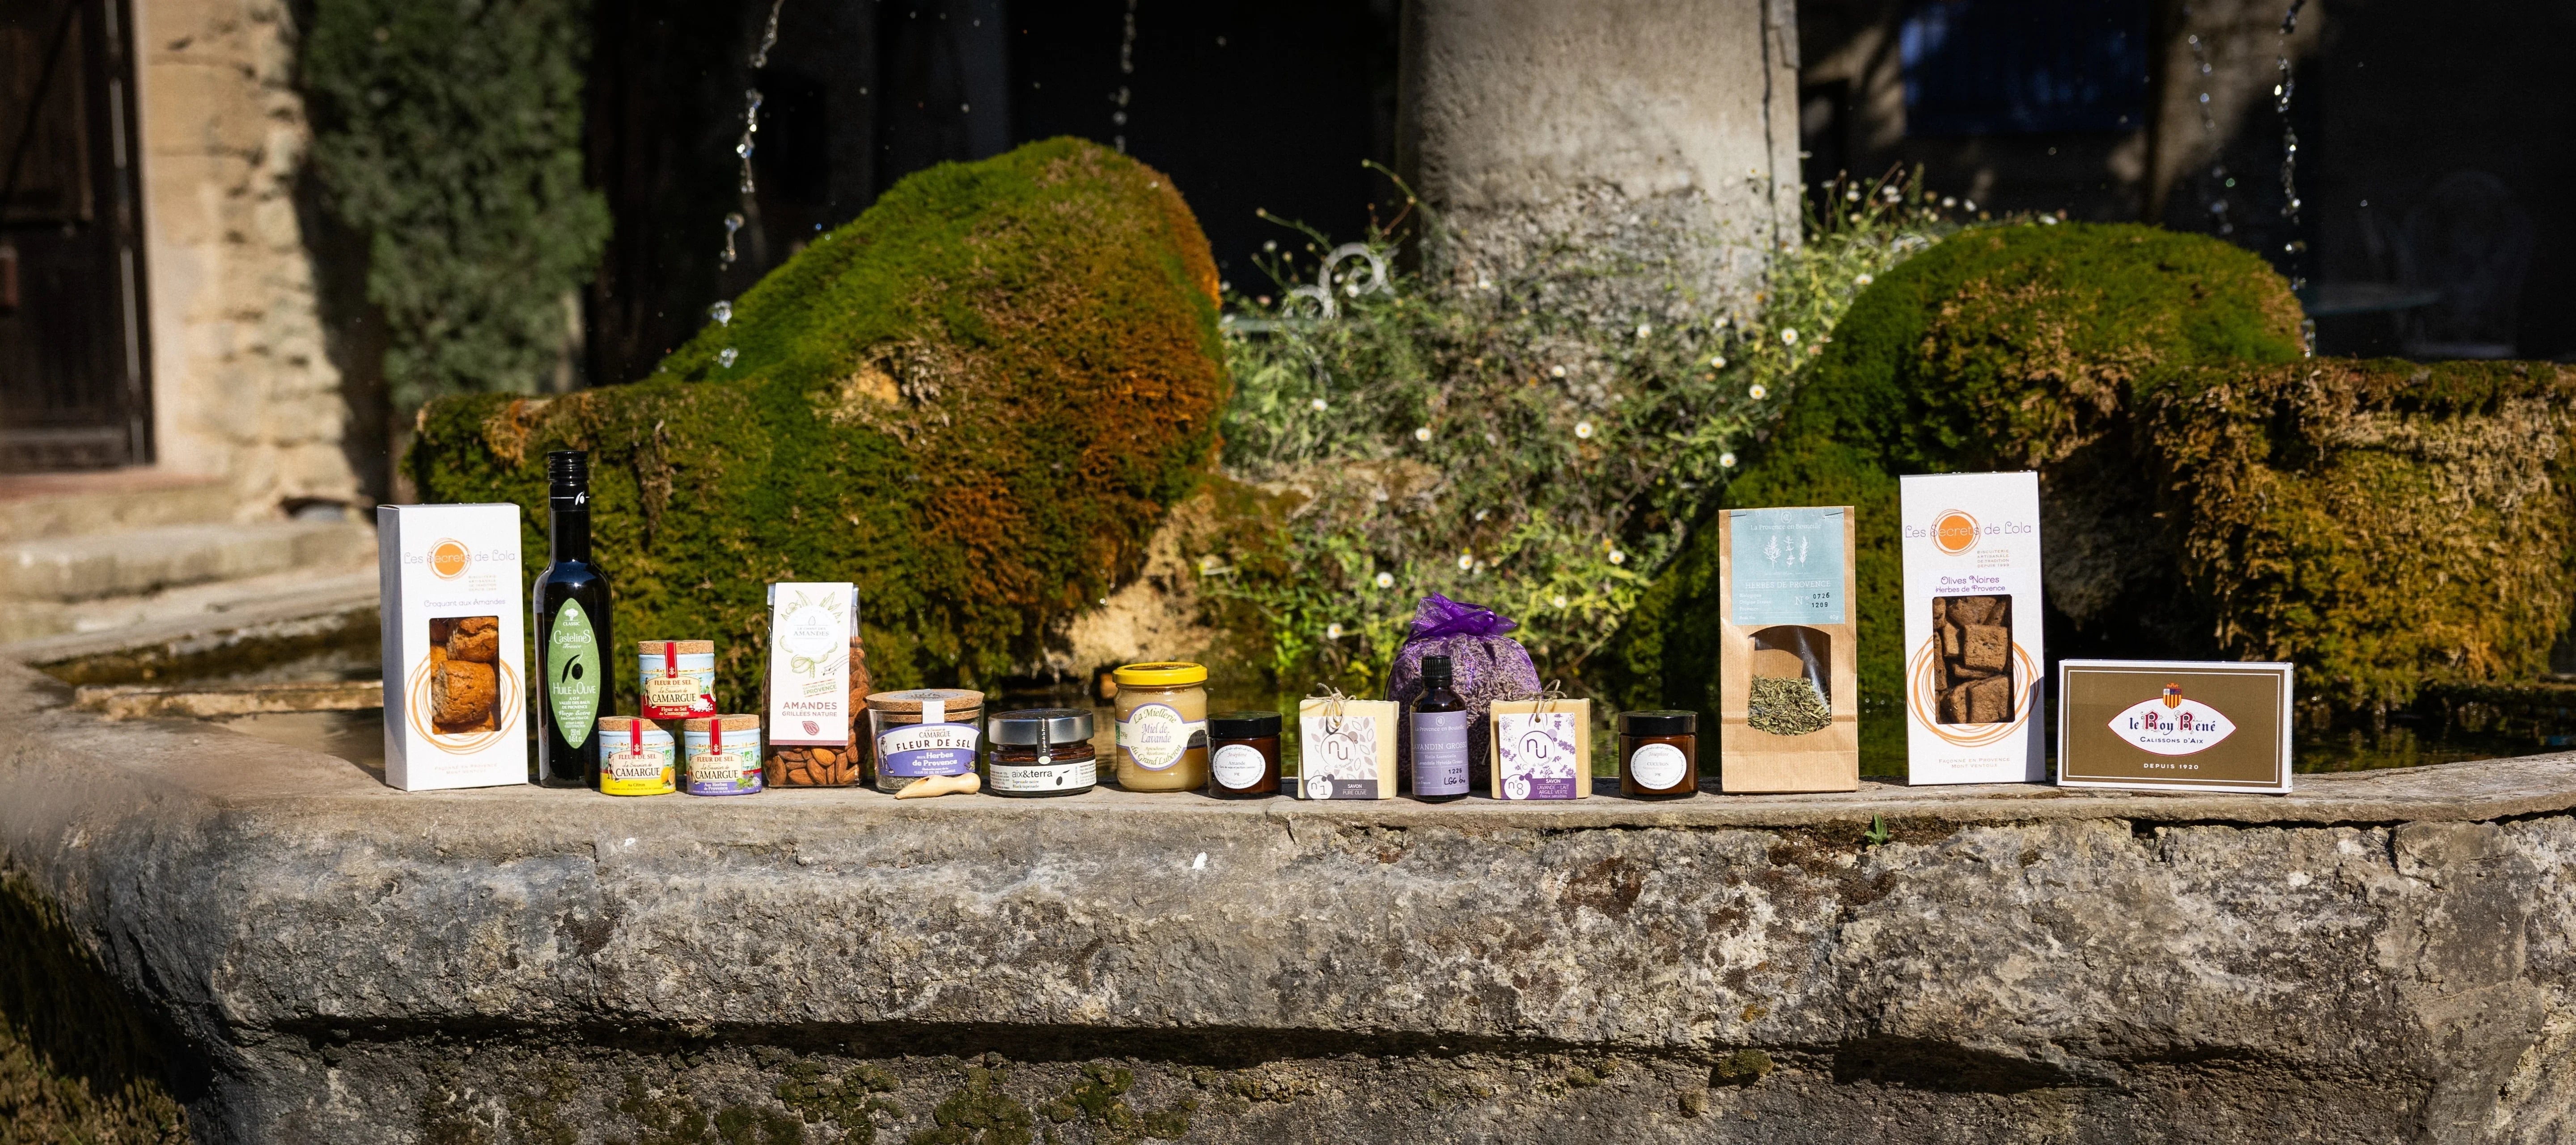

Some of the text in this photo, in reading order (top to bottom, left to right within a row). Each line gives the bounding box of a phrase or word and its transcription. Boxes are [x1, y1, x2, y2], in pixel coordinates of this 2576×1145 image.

[1905, 522, 2031, 538] Les Secrets de Lola
[404, 550, 515, 564] Les Secrets de Lola
[1941, 575, 2000, 585] Olives Noires
[424, 600, 457, 608] Croquant
[553, 682, 572, 695] HUILE
[807, 684, 837, 694] PROVENCE
[652, 694, 696, 703] CAMARGUE
[1133, 708, 1177, 724] La Miellerie
[2130, 709, 2216, 735] le Roy René
[1142, 722, 1167, 734] Miel de
[1141, 732, 1171, 743] Lavande
[897, 740, 930, 751] FLEUR
[956, 739, 970, 748] SEL
[1328, 741, 1348, 760] nu
[1527, 739, 1546, 759] nu
[1138, 753, 1157, 765] Grand
[1158, 744, 1182, 765] Luberon
[616, 768, 661, 777] CAMARGUE
[695, 770, 738, 779] CAMARGUE
